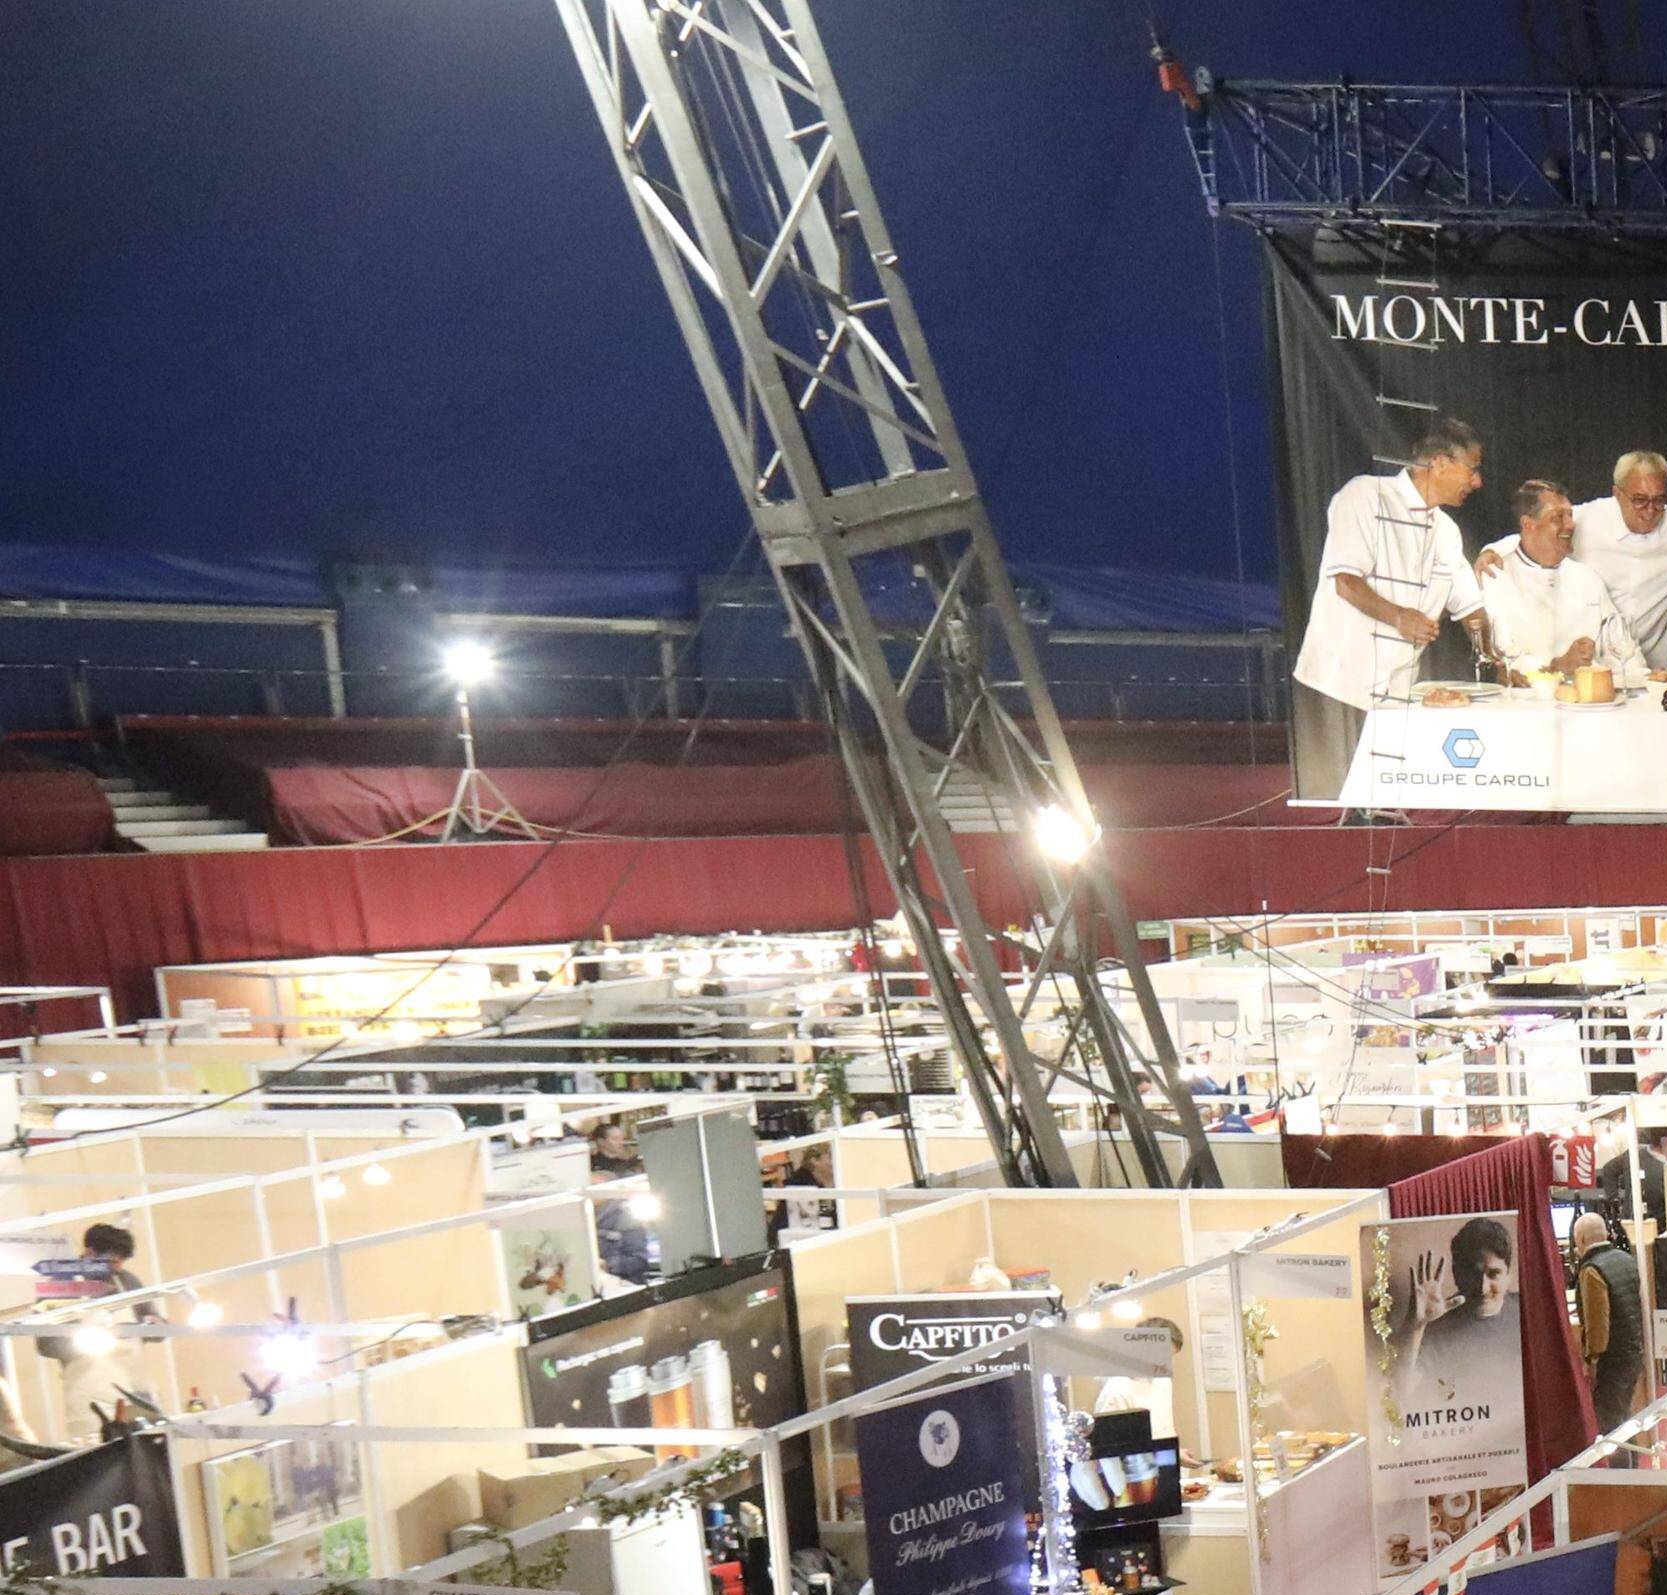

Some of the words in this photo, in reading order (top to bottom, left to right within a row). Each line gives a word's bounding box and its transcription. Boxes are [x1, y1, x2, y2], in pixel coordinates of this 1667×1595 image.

[1380, 773, 1467, 786] GROUPE
[1474, 775, 1549, 787] CAROLI
[870, 1313, 1015, 1350] CAPFITO
[1123, 1333, 1166, 1343] CAPFITO
[1406, 1405, 1490, 1428] MITRON
[1422, 1425, 1475, 1439] BAKERY
[1432, 1454, 1476, 1464] ARTISANALE
[1414, 1475, 1442, 1485] MAURO
[890, 1481, 1004, 1535] CHAMPAGNE
[52, 1503, 148, 1578] BAR
[896, 1534, 958, 1567] Philippe
[960, 1519, 1006, 1546] Doury
